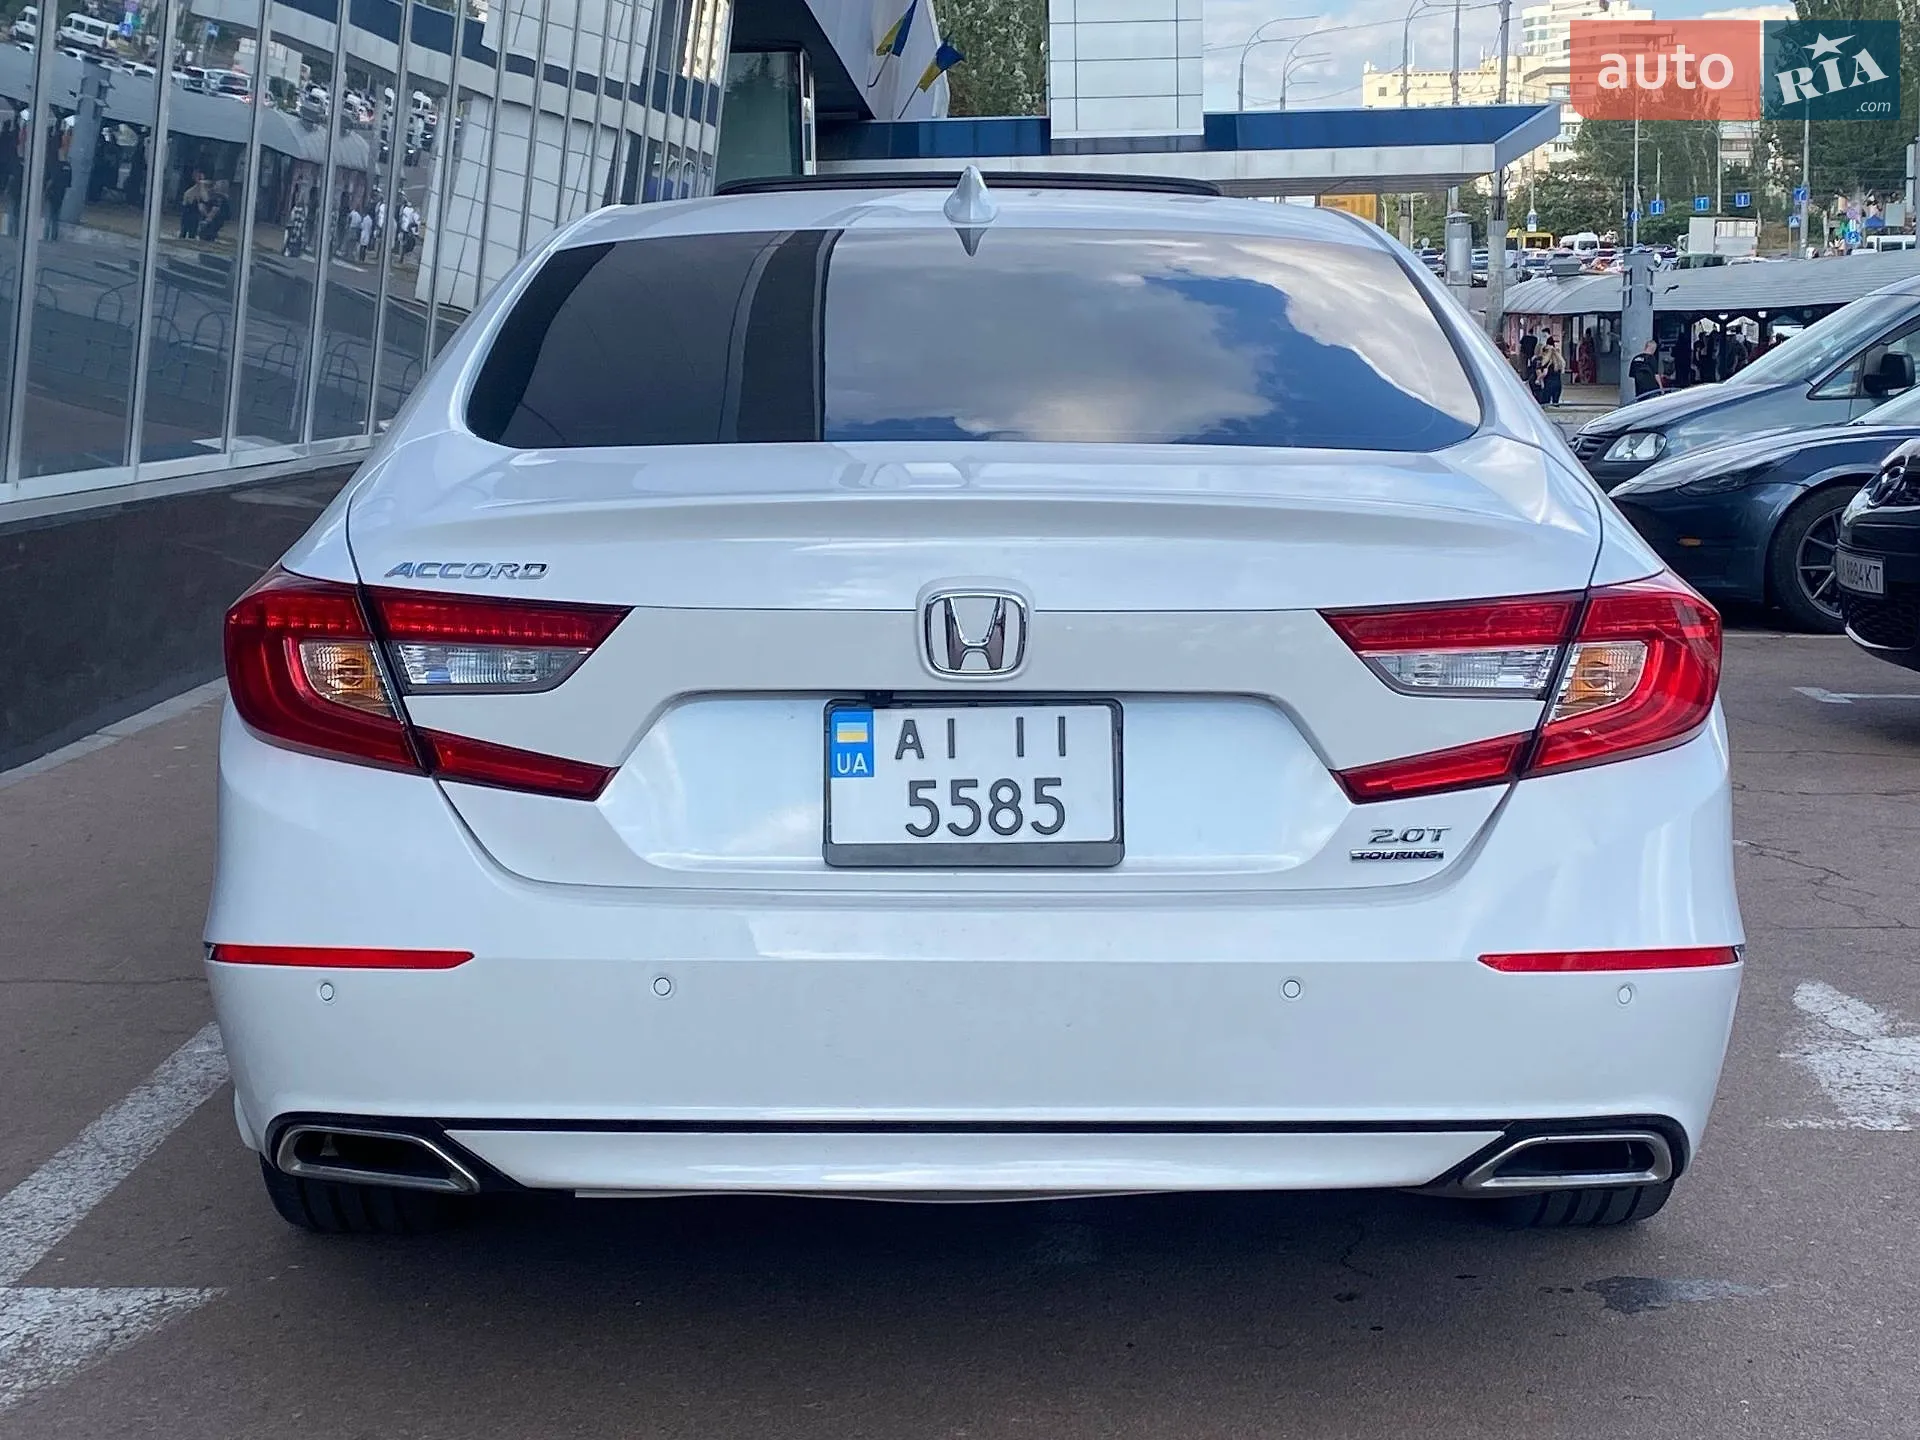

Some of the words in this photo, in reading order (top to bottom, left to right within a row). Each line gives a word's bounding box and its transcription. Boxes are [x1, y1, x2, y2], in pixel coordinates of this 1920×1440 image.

[384, 562, 550, 579] ACCORD
[895, 718, 955, 760] AI
[836, 752, 869, 774] UA
[905, 778, 1066, 838] 5585
[1368, 827, 1452, 844] 2.0T
[1355, 850, 1443, 860] TOURING
